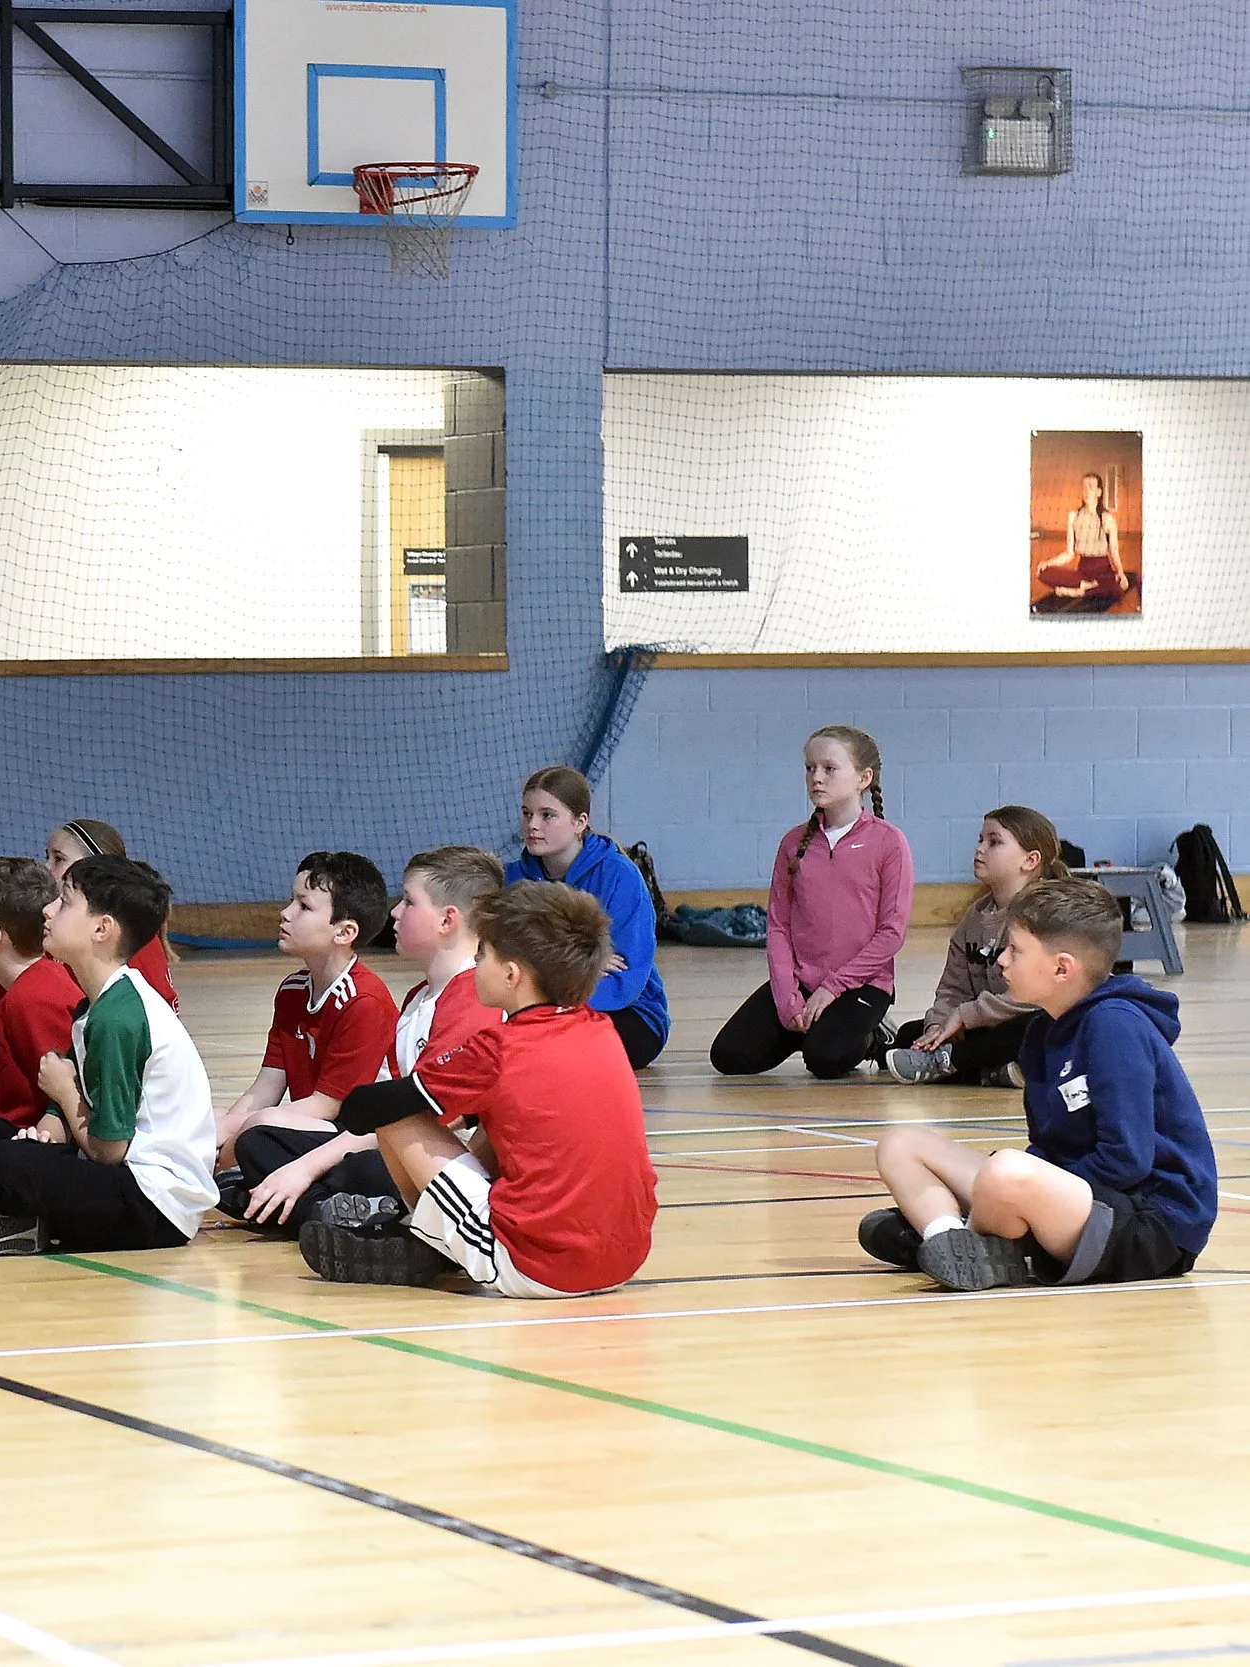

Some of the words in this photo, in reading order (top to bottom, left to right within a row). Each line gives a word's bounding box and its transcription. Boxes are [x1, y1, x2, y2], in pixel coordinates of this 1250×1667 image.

[654, 566, 668, 576] Wet
[675, 566, 688, 577] Dry
[688, 566, 722, 577] Changing
